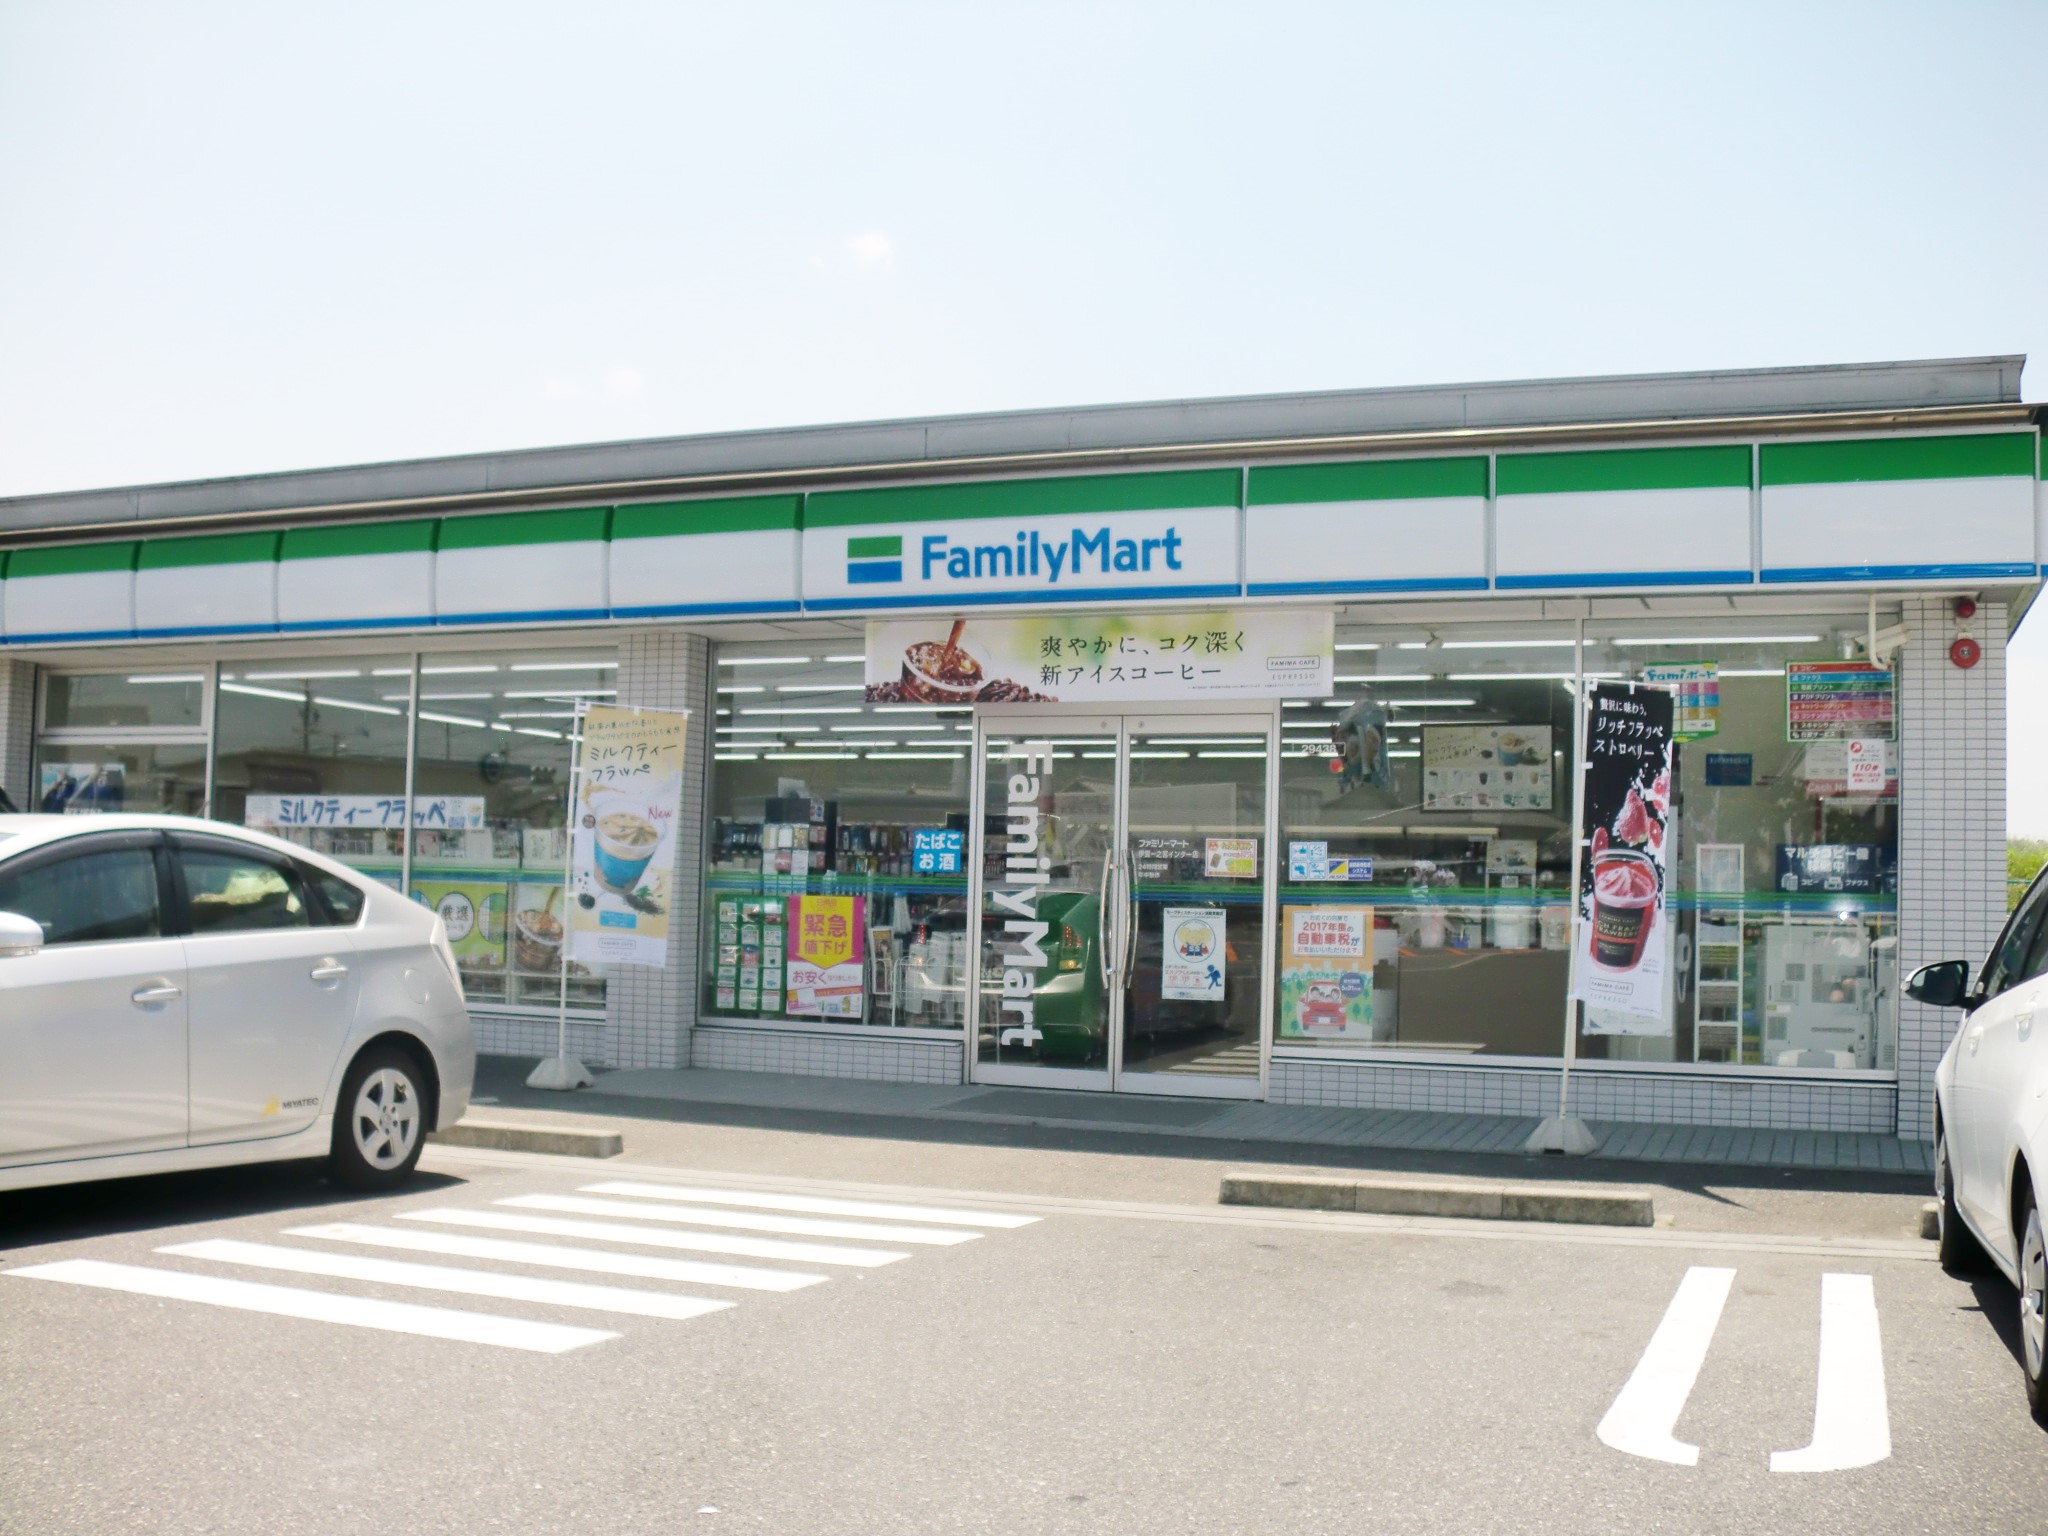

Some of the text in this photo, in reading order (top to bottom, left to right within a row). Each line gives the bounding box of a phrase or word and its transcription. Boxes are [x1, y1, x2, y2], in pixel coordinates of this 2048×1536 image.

[922, 527, 1182, 583] FamilyMart
[1040, 630, 1245, 658] 爽やかに、コク深く
[1040, 664, 1222, 686] 新アイスコーヒー
[1596, 716, 1664, 740] リッチフラッペ
[590, 743, 677, 760] ミルクティー
[1301, 744, 1337, 754] 29438
[1592, 739, 1655, 760] ストロベリー
[592, 763, 651, 781] フラッペ
[278, 799, 446, 825] ミルクティーフラッペ
[648, 805, 673, 819] New
[915, 833, 960, 850] たばこ
[1138, 839, 1190, 848] ファミリーマート
[918, 853, 955, 871] お酒
[992, 744, 1054, 1047] FamilyMart
[804, 914, 848, 938] 緊急
[804, 939, 847, 955] 値下げ
[1298, 932, 1360, 946] 自動車税が
[792, 970, 827, 985] お安く
